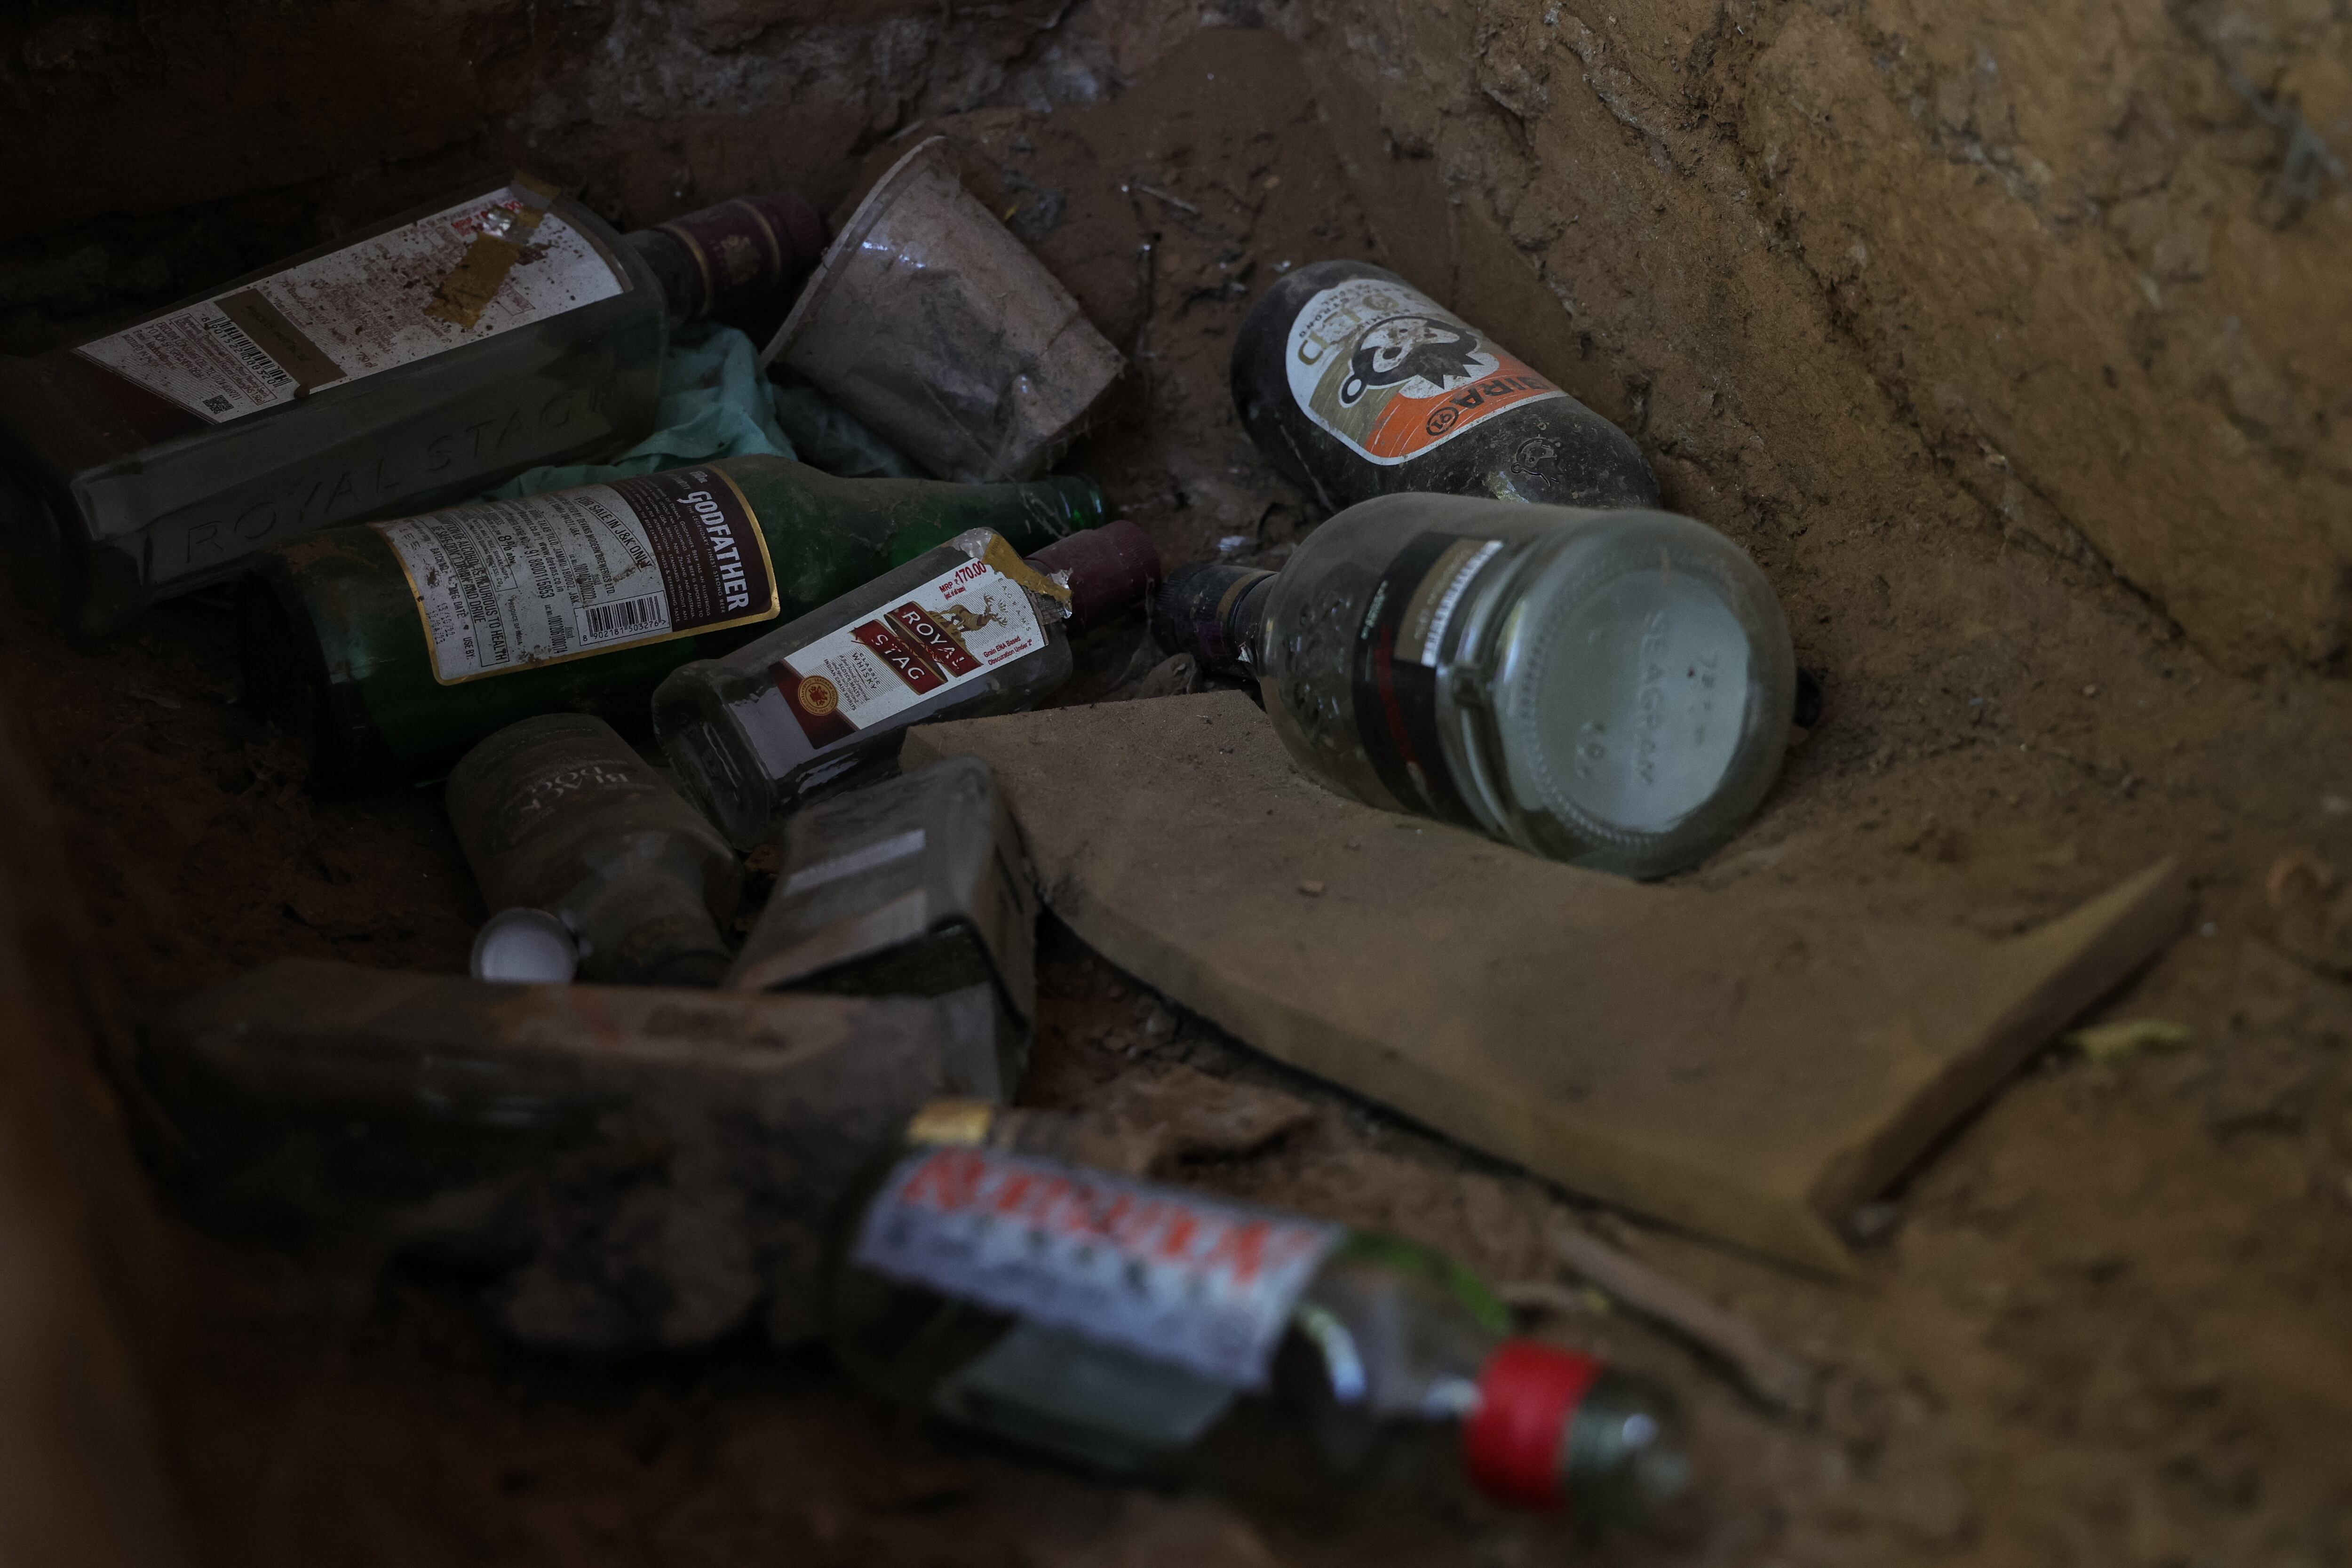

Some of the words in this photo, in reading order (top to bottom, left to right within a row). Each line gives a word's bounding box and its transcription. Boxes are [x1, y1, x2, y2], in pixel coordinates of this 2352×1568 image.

[1431, 412, 1453, 430] 91
[452, 533, 467, 541] OF
[511, 525, 526, 536] CARE
[568, 526, 582, 538] J&K.
[573, 496, 596, 507] FOR
[587, 504, 613, 521] SALE
[604, 519, 622, 529] IN
[613, 528, 636, 546] J&K
[628, 545, 653, 569] ONLY
[576, 518, 593, 534] DEVANS
[429, 547, 445, 563] BATCH
[523, 549, 540, 558] 91
[584, 533, 603, 554] MODERN
[676, 490, 753, 612] GODFATHER
[686, 505, 695, 514] THE
[691, 515, 710, 546] LEGENDARY
[706, 548, 717, 568] FINEST
[712, 570, 724, 597] STRONG
[453, 560, 474, 583] DRINK
[500, 566, 510, 581] HOPS,
[594, 553, 612, 583] BREWERIES
[652, 518, 671, 551] INTERNATIONAL
[667, 553, 681, 582] STANDARDS
[676, 583, 686, 608] WITHOUT
[676, 555, 688, 578] ZEALAND
[679, 520, 695, 549] GODFATHER
[691, 549, 699, 562] BEER
[700, 584, 712, 616] ILLUSTRIOUS
[527, 557, 556, 599] 8800115853
[604, 582, 616, 596] LTD.
[939, 581, 953, 593] MRP
[462, 582, 480, 600] AND
[473, 575, 499, 616] INJURIOUS
[568, 591, 580, 606] J&K.
[666, 575, 678, 606] REFRESHING
[692, 583, 702, 609] EXPORTED
[468, 600, 486, 624] DRIVE
[486, 616, 502, 629] TO
[507, 598, 518, 622] PRODUCE
[515, 630, 524, 645] INDIA
[547, 614, 568, 654] 10012061000174
[592, 627, 626, 640] 902181
[626, 620, 660, 633] 503276
[901, 610, 965, 670] ROYAL
[462, 636, 474, 649] USE
[489, 629, 508, 661] HEALTH
[996, 642, 1007, 652] ENA
[1006, 636, 1021, 647] Based
[464, 649, 476, 660] BY:
[870, 632, 925, 681] STAG
[988, 649, 1016, 666] Obscuration
[1014, 643, 1028, 653] Under
[837, 662, 852, 682] SCOTCH
[848, 681, 862, 698] MALTS
[845, 665, 857, 679] blend
[850, 652, 878, 691] WHISKY
[858, 652, 882, 686] CLASSIC
[823, 658, 837, 677] INDIAN
[834, 676, 847, 692] GRAIN
[842, 692, 858, 711] SPIRITS
